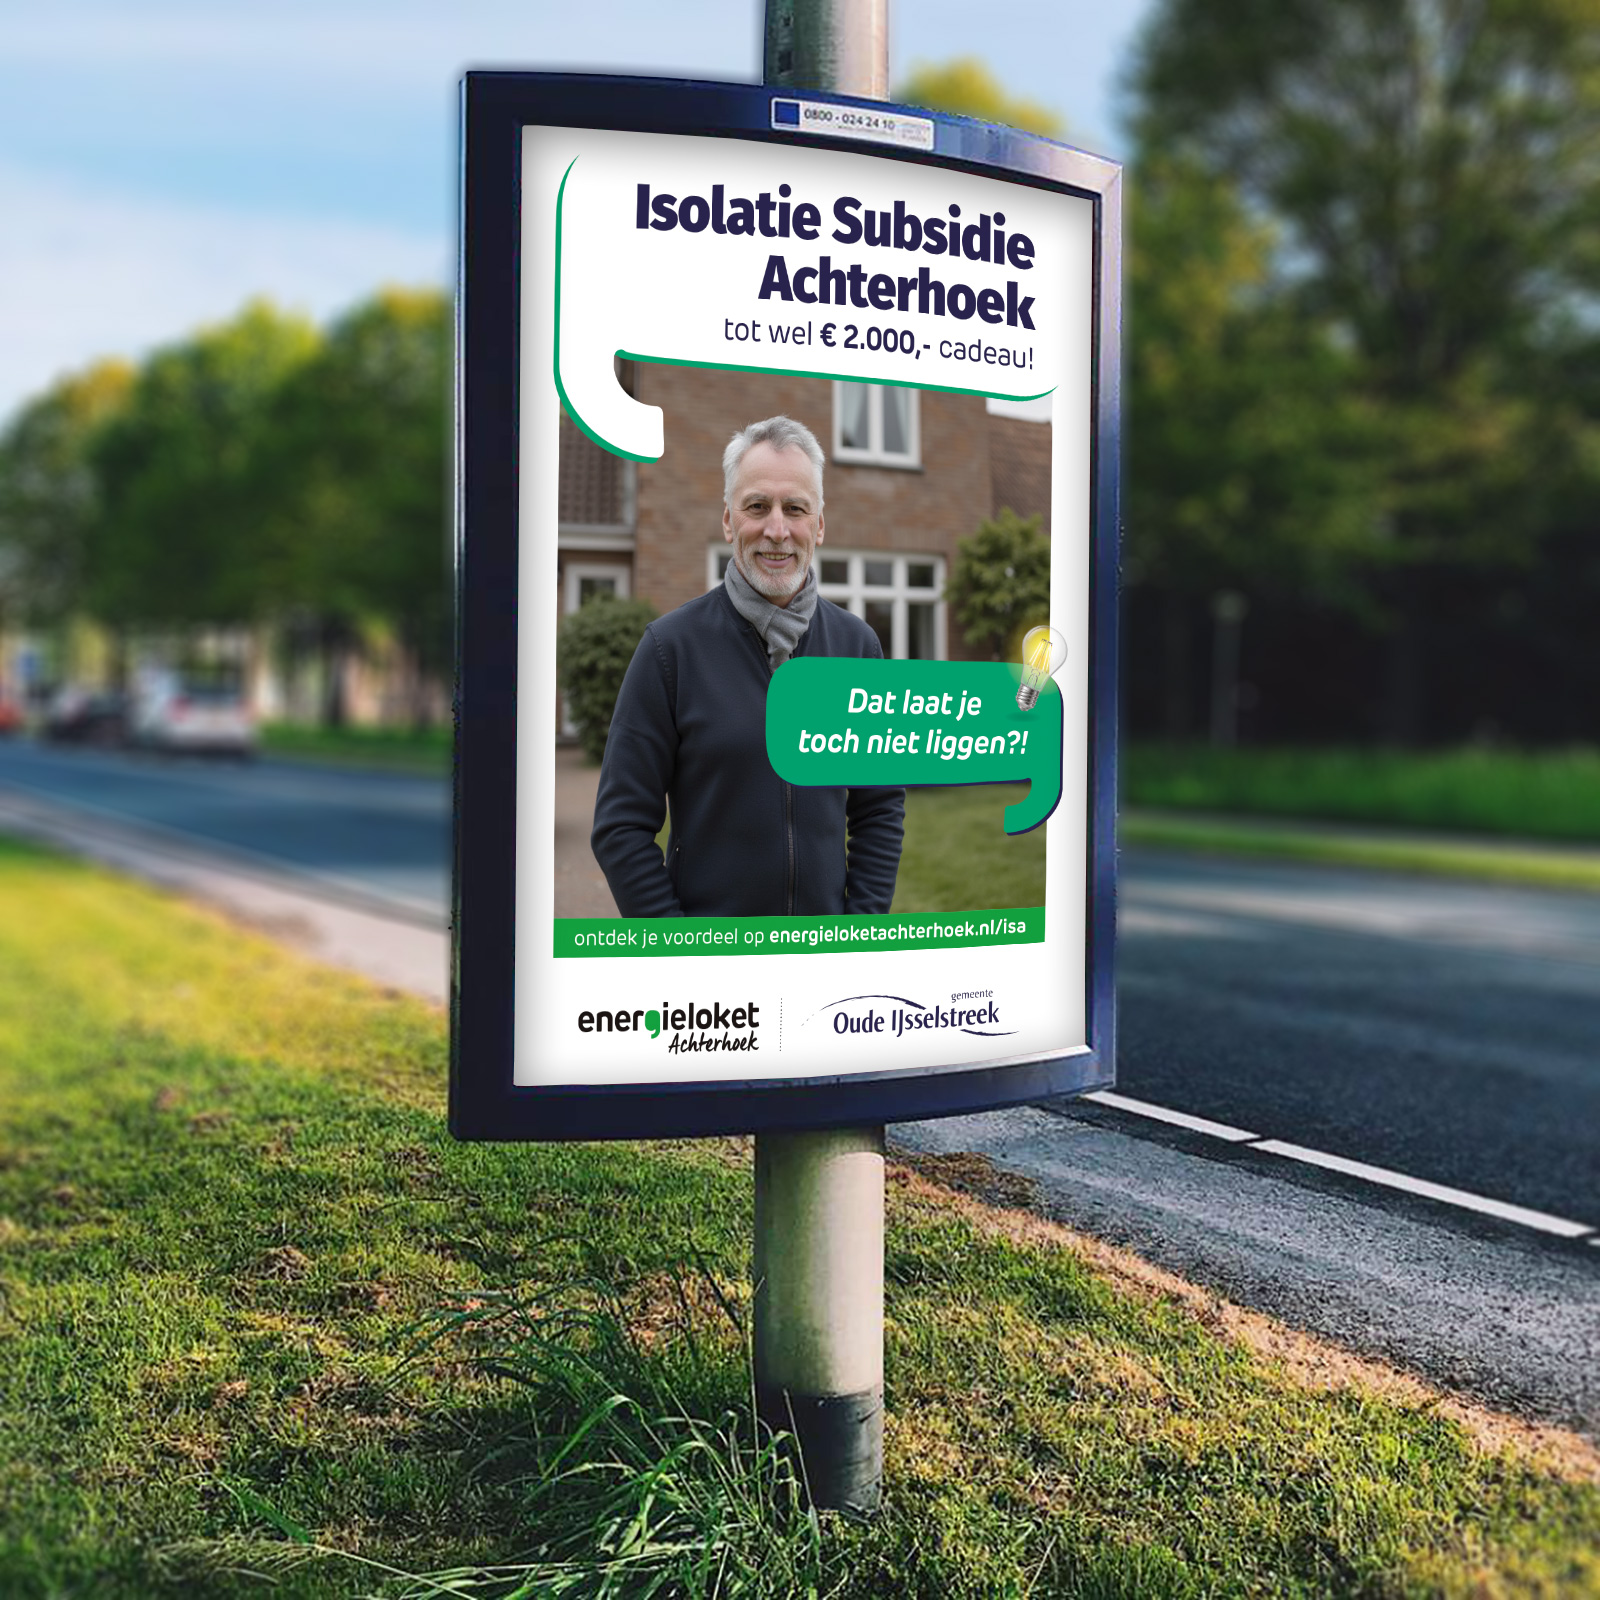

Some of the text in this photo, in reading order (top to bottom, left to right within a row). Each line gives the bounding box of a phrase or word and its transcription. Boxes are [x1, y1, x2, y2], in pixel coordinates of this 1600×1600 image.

[803, 107, 833, 122] 0800
[881, 119, 896, 131] 10
[636, 184, 1036, 270] Isolatie Subsidie
[757, 254, 1036, 331] Achterhoek
[725, 319, 1032, 369] tot wel € 2.000,- cadeau!
[848, 688, 981, 721] Dat laat je
[799, 728, 1028, 760] toch niet liggen?!
[575, 918, 1027, 948] ontdek je voordeel op energieloketachterhoek.nl/isa
[950, 988, 994, 1004] gemeente
[577, 1002, 760, 1039] energieloket
[833, 1001, 1001, 1038] Oude IJsselstreek
[668, 1031, 760, 1055] Achterhoek
